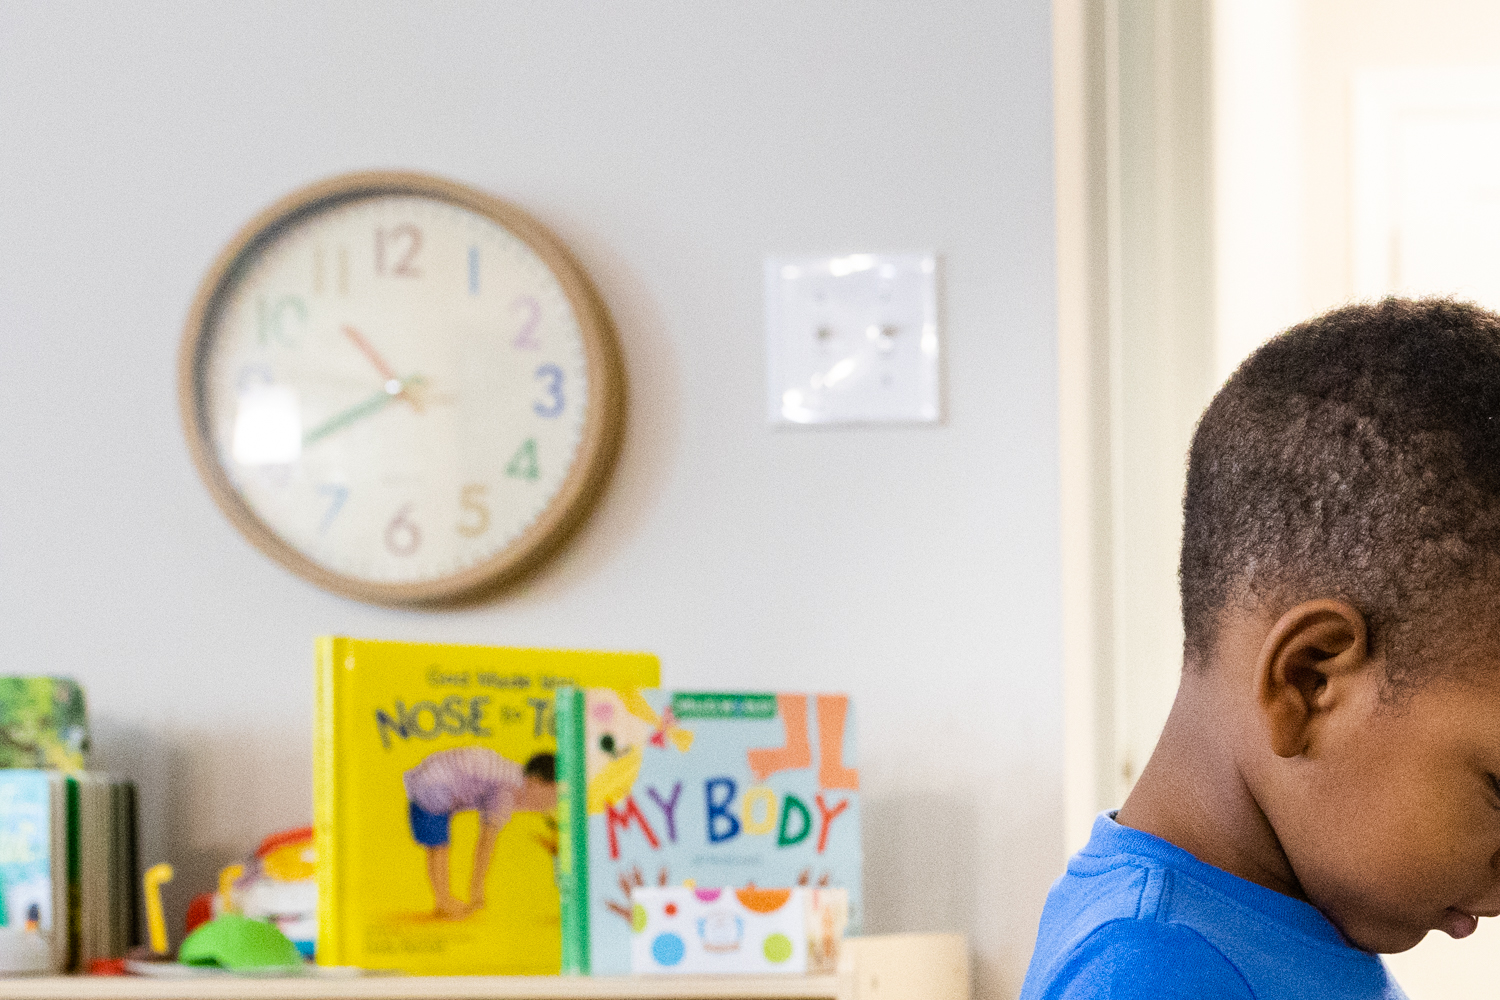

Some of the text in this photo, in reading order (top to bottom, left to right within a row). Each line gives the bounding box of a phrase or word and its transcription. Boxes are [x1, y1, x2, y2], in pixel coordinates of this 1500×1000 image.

[312, 244, 350, 297] 11
[374, 222, 423, 278] 12
[467, 245, 480, 296] 1
[513, 295, 542, 351] 2
[534, 363, 565, 419] 3
[504, 437, 541, 481] 4
[316, 484, 348, 537] 7
[383, 502, 422, 557] 6
[457, 484, 491, 539] 5
[374, 694, 492, 750] NOSE
[603, 775, 849, 861] MY BODY
